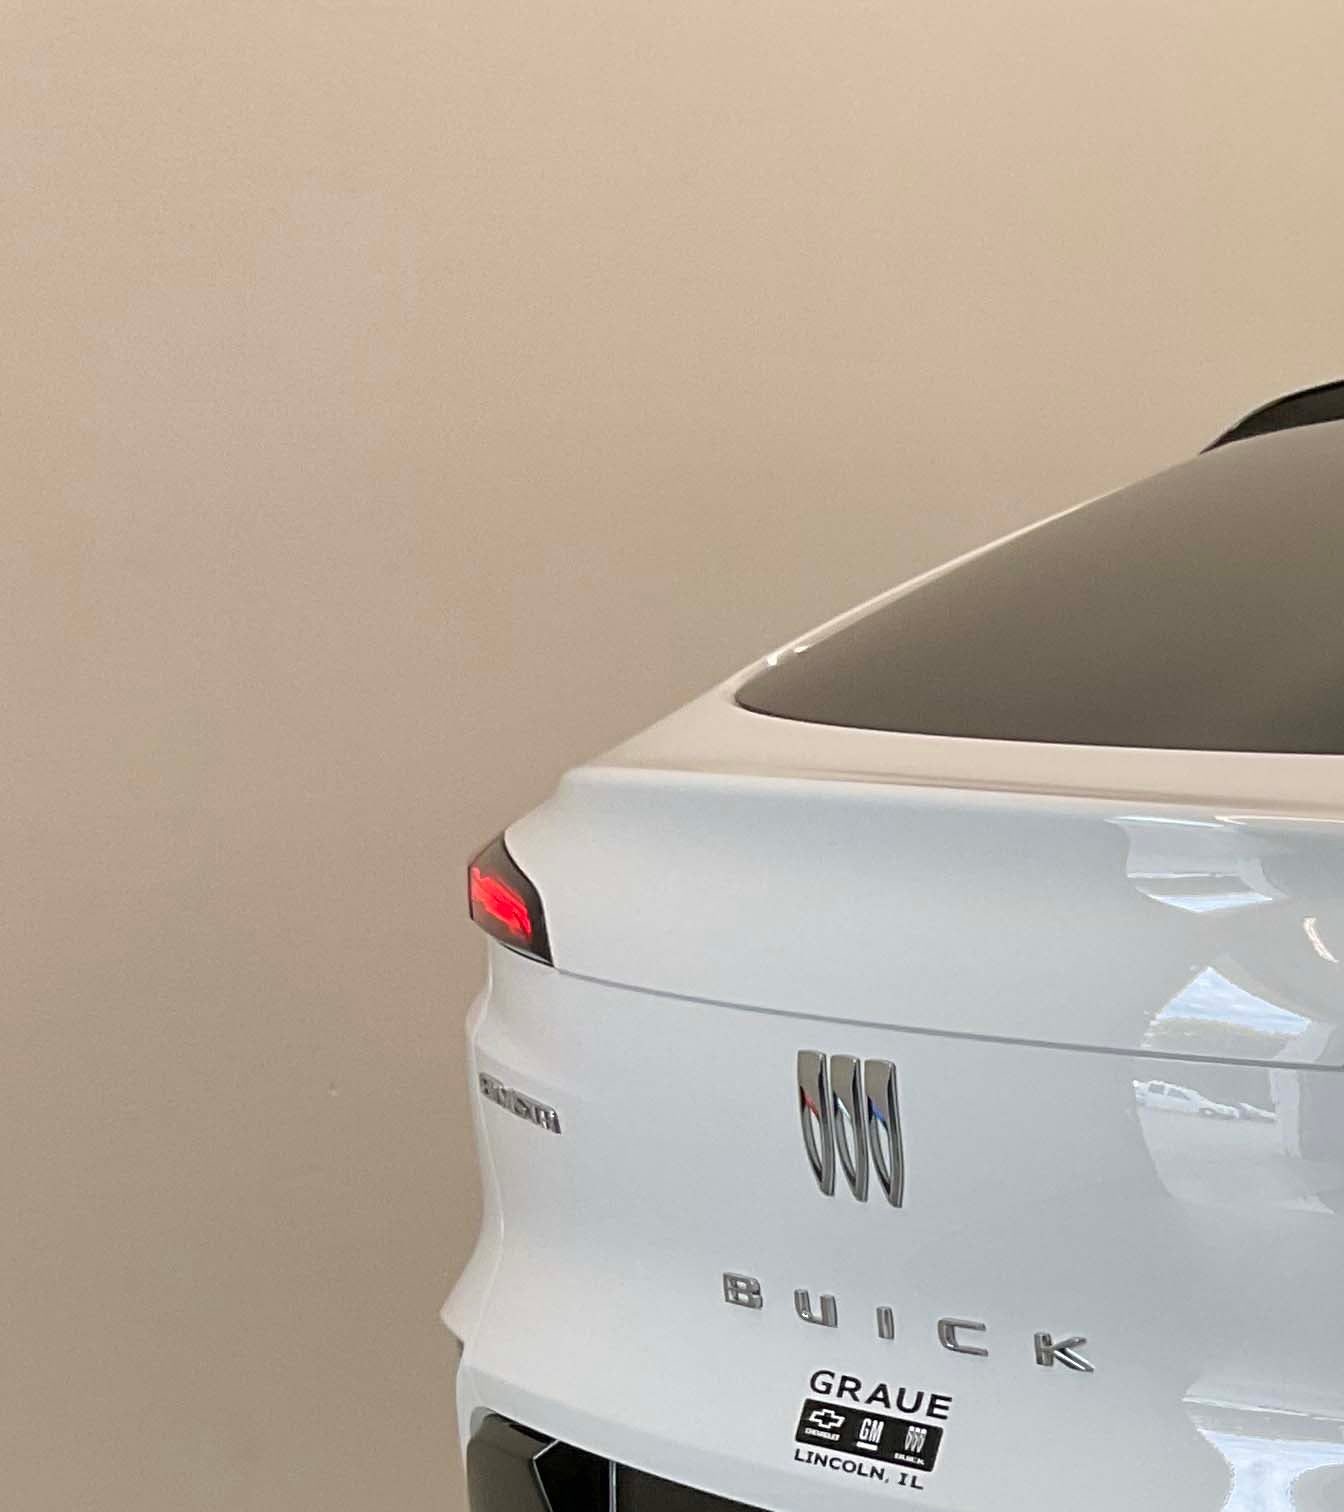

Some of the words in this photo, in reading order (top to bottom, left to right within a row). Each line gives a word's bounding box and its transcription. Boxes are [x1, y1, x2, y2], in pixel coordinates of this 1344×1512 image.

[723, 1271, 1094, 1373] BUICK
[809, 1369, 953, 1420] GRAUE
[858, 1417, 885, 1444] GM
[794, 1448, 890, 1484] LINCOLN,
[897, 1472, 925, 1490] IL
